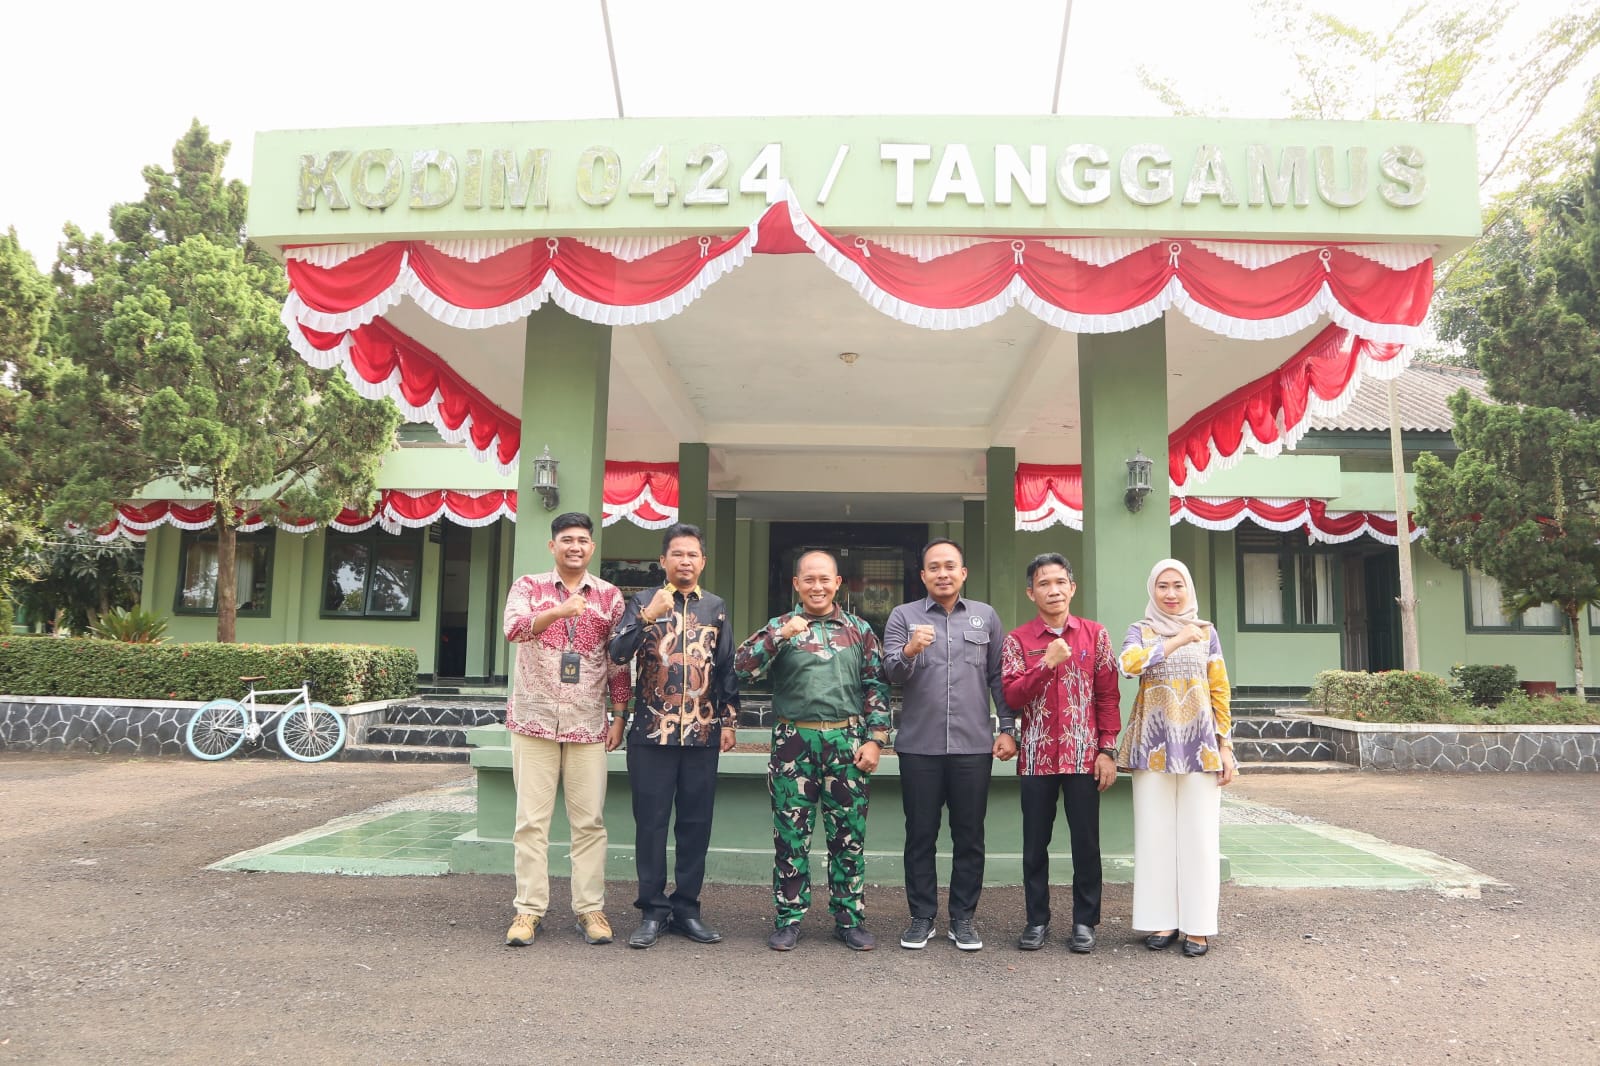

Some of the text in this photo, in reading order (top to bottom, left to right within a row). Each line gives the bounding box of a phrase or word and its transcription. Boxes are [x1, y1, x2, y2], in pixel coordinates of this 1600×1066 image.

[297, 142, 1427, 211] KODIM 0424 / TANGGAMUS
